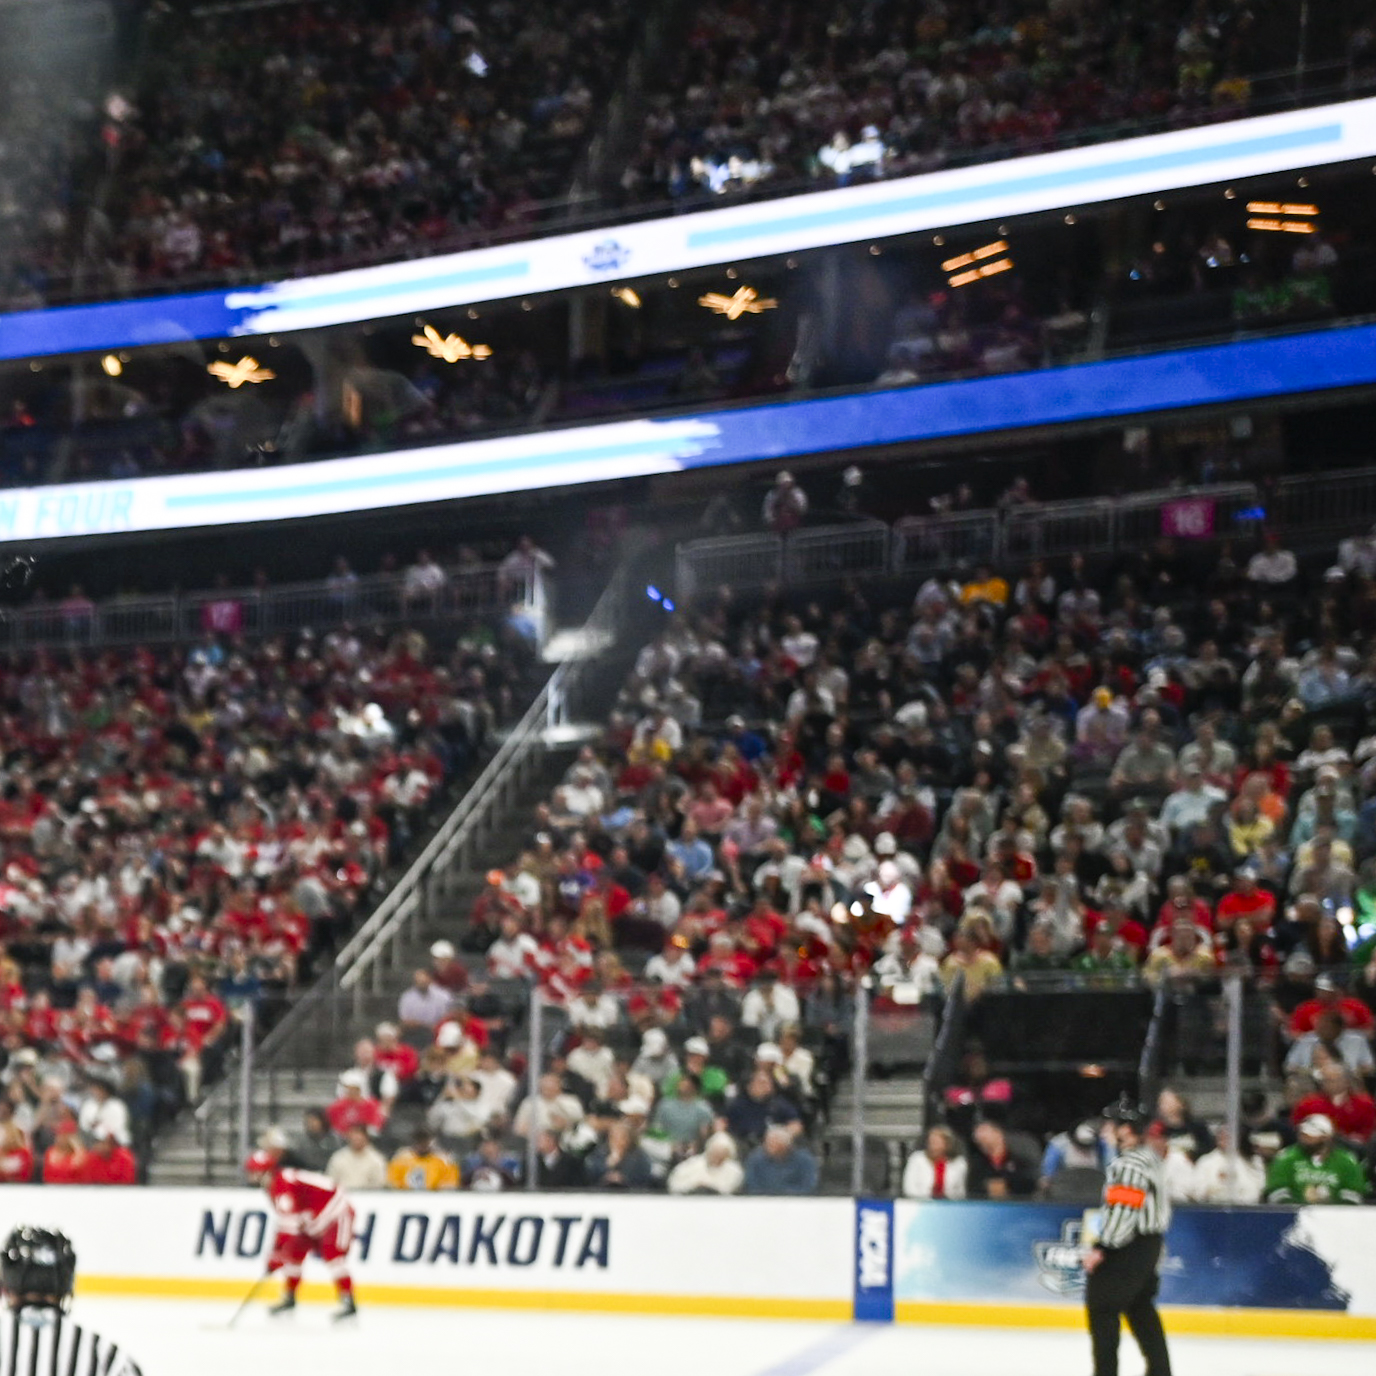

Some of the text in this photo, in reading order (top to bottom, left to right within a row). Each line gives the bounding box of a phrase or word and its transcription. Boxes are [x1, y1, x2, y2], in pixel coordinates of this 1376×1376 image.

[35, 490, 134, 539] FOUR
[195, 1210, 611, 1268] NOH DAKOTA
[859, 1208, 888, 1288] NCAA
